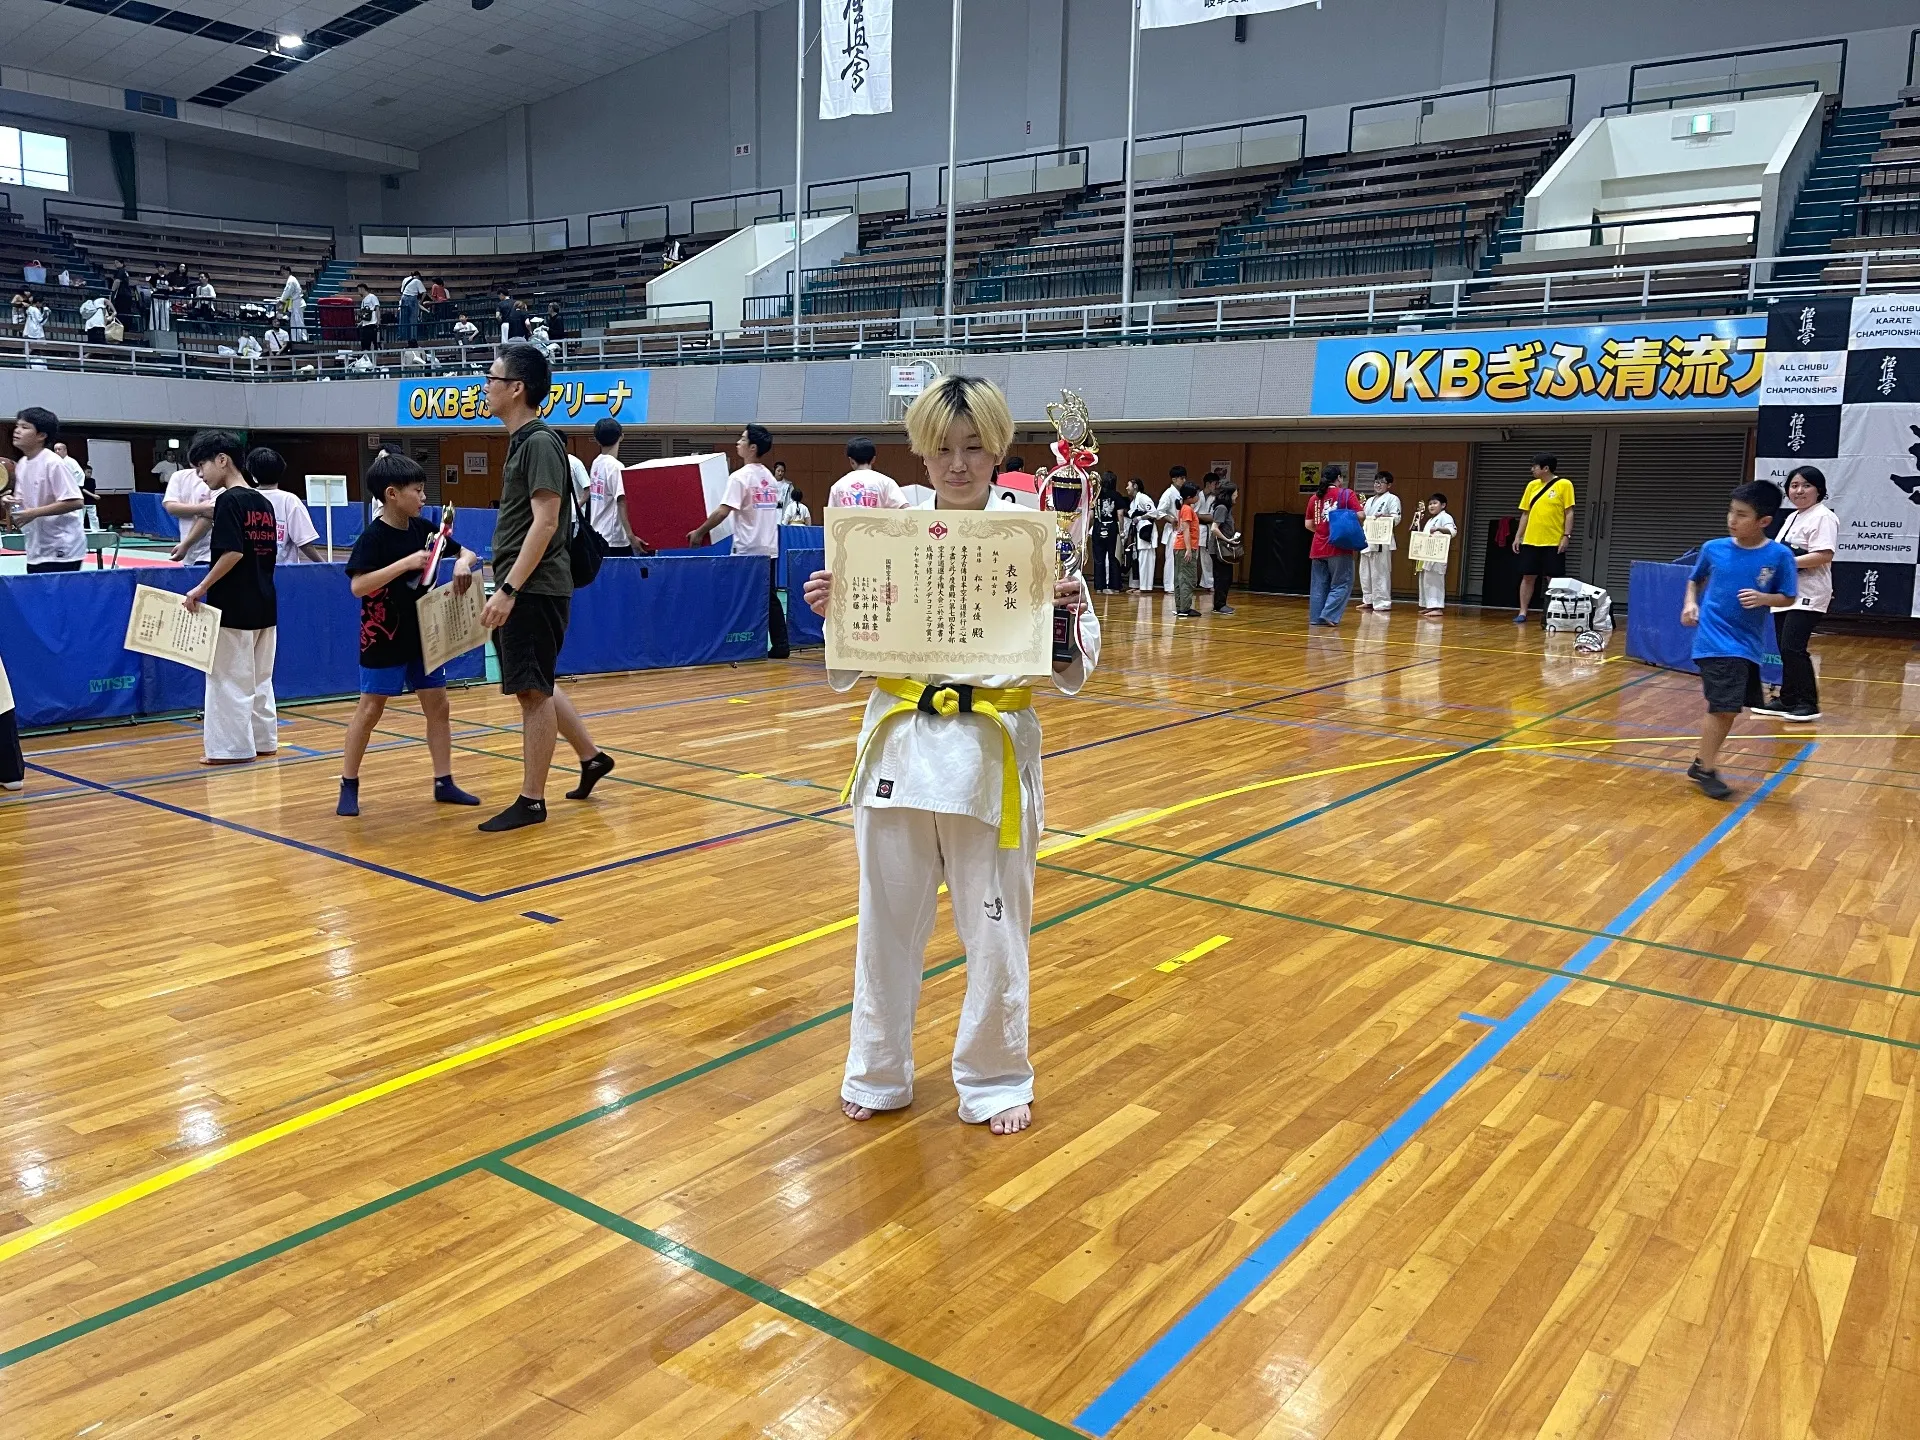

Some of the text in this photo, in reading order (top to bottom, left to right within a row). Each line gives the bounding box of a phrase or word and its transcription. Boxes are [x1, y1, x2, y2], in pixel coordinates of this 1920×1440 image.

[1869, 305, 1920, 314] ALL CHUBU
[1875, 317, 1912, 325] KARATE
[1797, 363, 1829, 371] CHUBU
[1765, 386, 1838, 394] CHAMPIONSHIPS
[1838, 543, 1912, 552] CHAMPIONSHIPS
[1004, 563, 1018, 610] 表彰状
